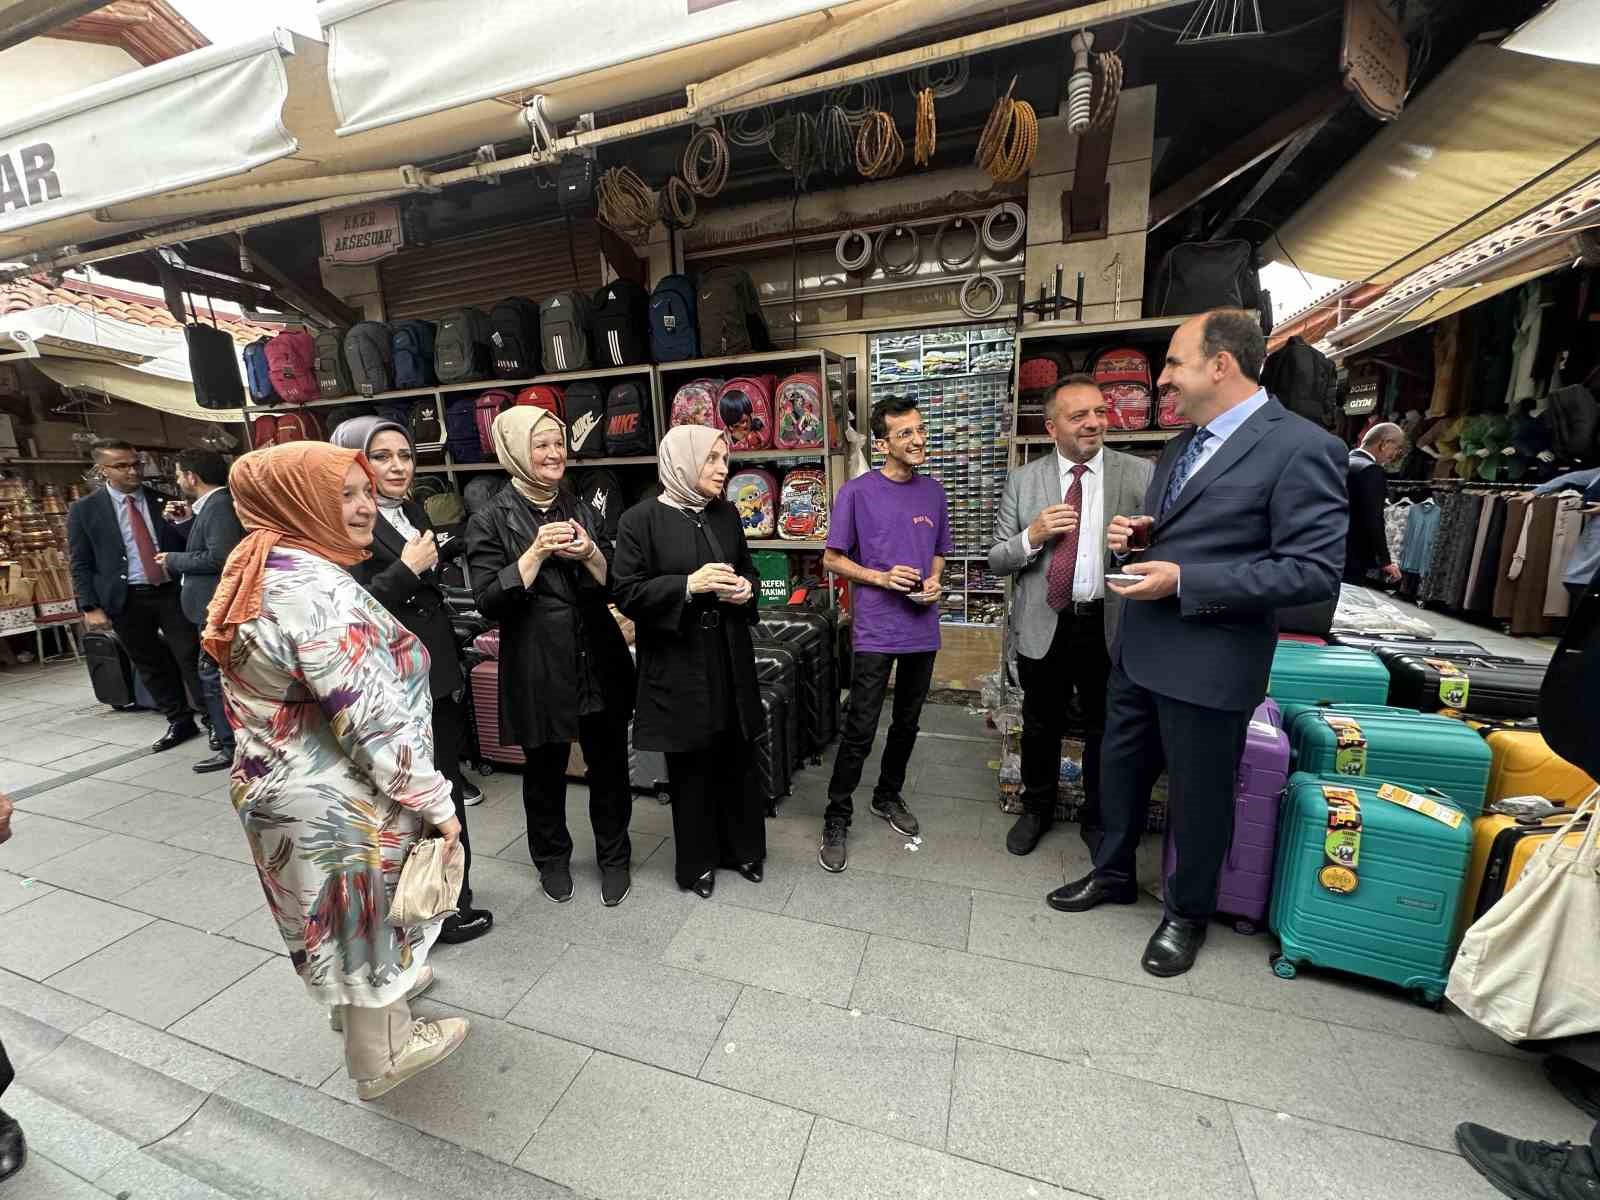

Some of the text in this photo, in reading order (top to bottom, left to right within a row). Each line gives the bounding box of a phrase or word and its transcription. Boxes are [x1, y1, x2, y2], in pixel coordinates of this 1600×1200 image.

[334, 229, 393, 252] AKSESUAR
[607, 412, 641, 436] NIKE
[761, 579, 785, 588] KEFEN
